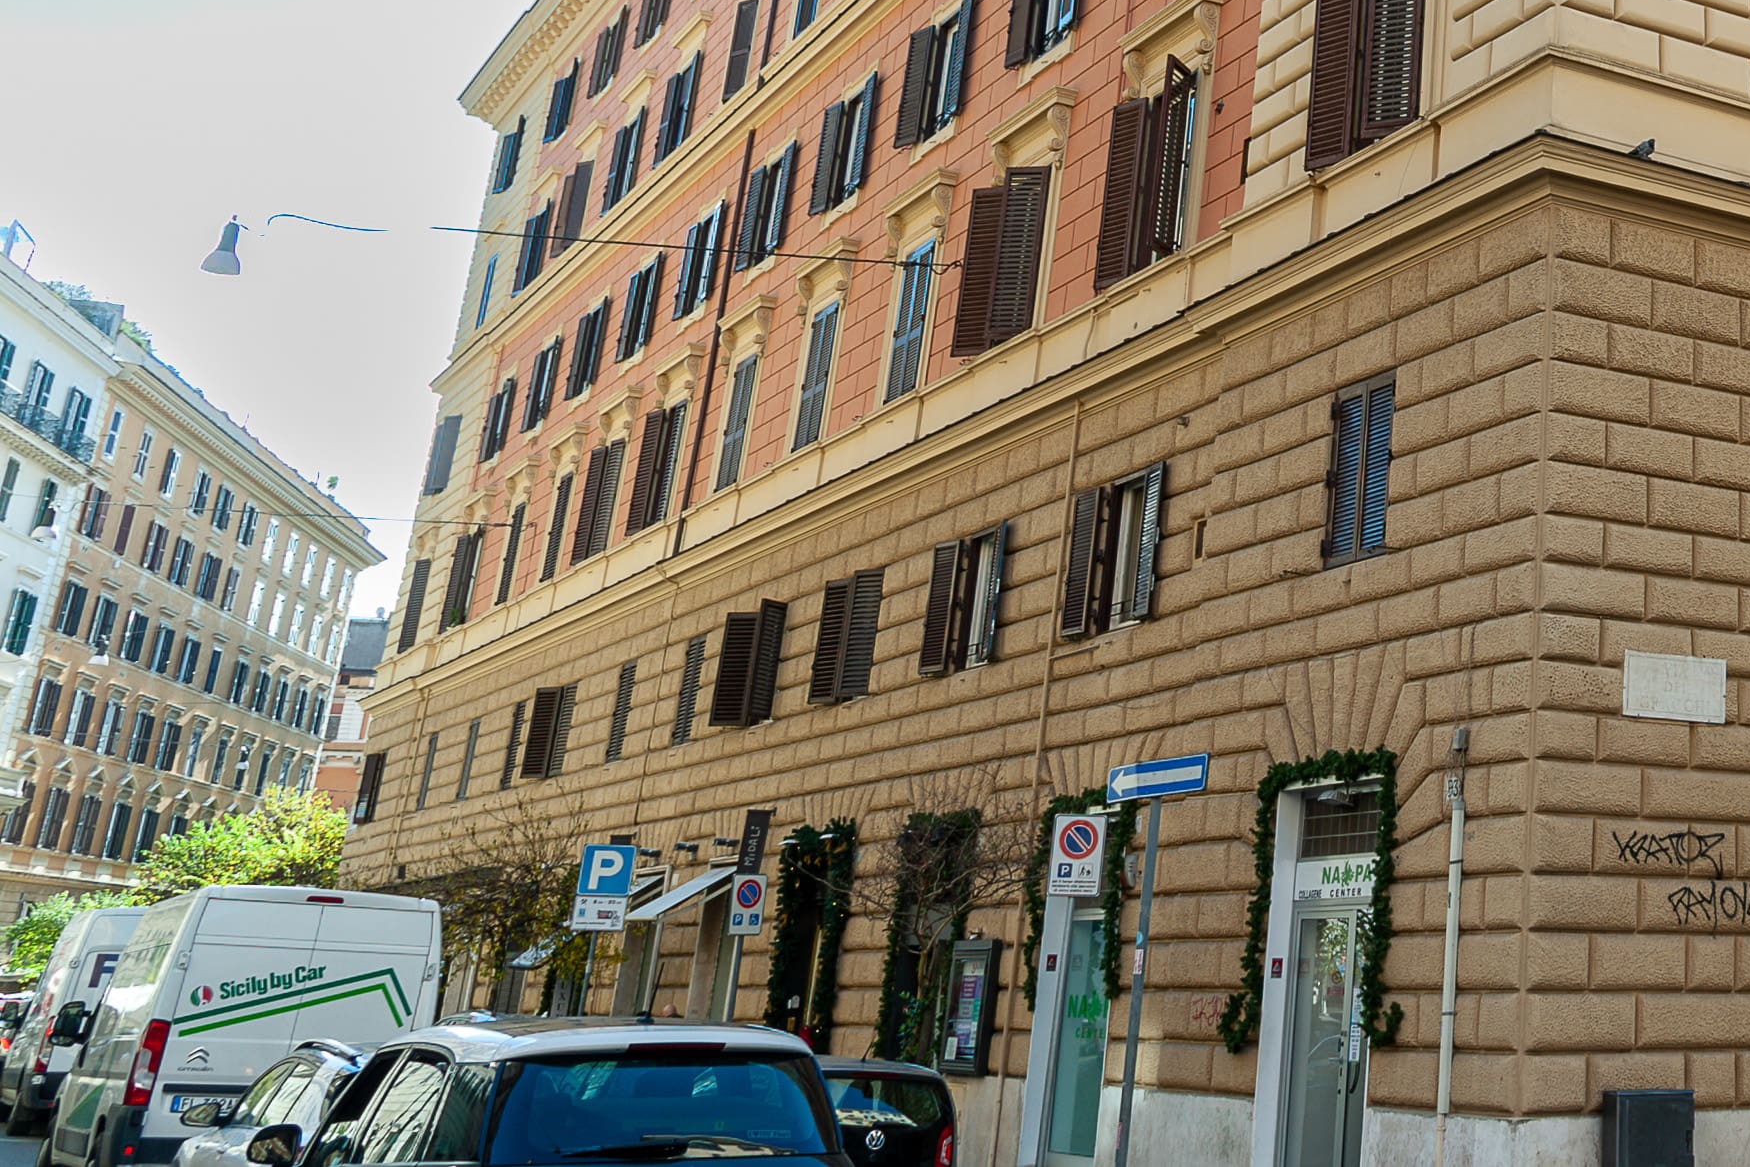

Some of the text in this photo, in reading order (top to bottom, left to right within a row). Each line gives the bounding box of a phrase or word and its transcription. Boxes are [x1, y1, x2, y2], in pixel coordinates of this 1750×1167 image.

[587, 850, 625, 891] P
[1329, 887, 1362, 898] CENTER
[219, 965, 327, 1001] Sicily by Car
